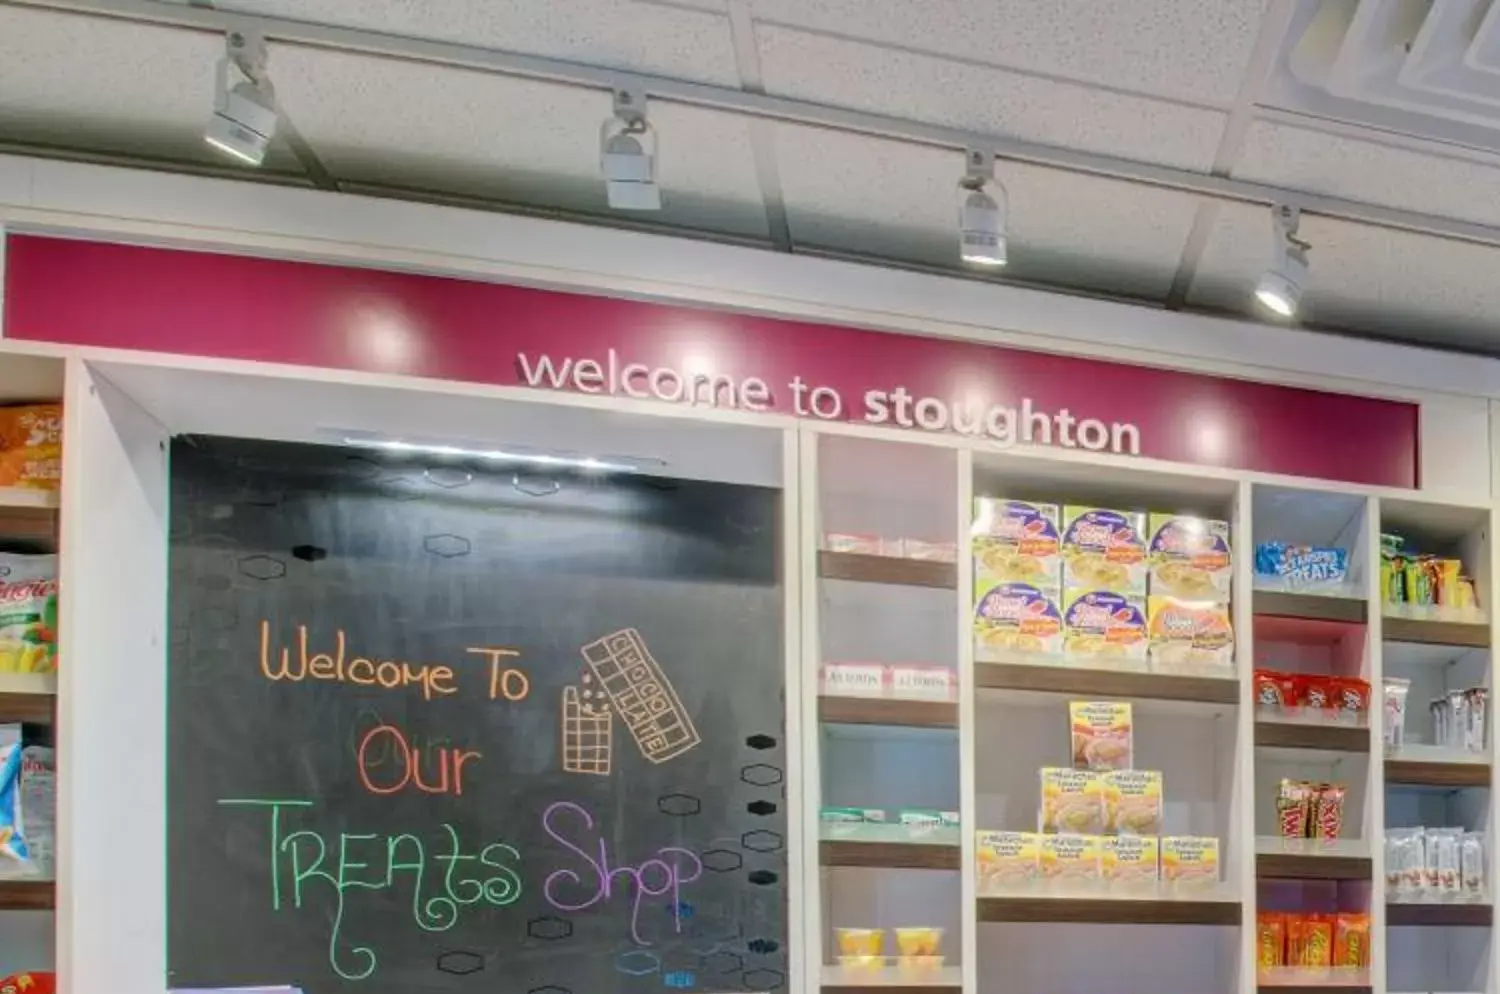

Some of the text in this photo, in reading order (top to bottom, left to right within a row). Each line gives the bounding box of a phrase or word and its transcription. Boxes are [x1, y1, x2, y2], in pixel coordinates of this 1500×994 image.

[518, 349, 1140, 455] welcome to stoughton
[261, 619, 529, 701] Welcome To
[611, 637, 667, 713] CHOCO
[358, 725, 482, 795] Our
[542, 801, 702, 945] Shop
